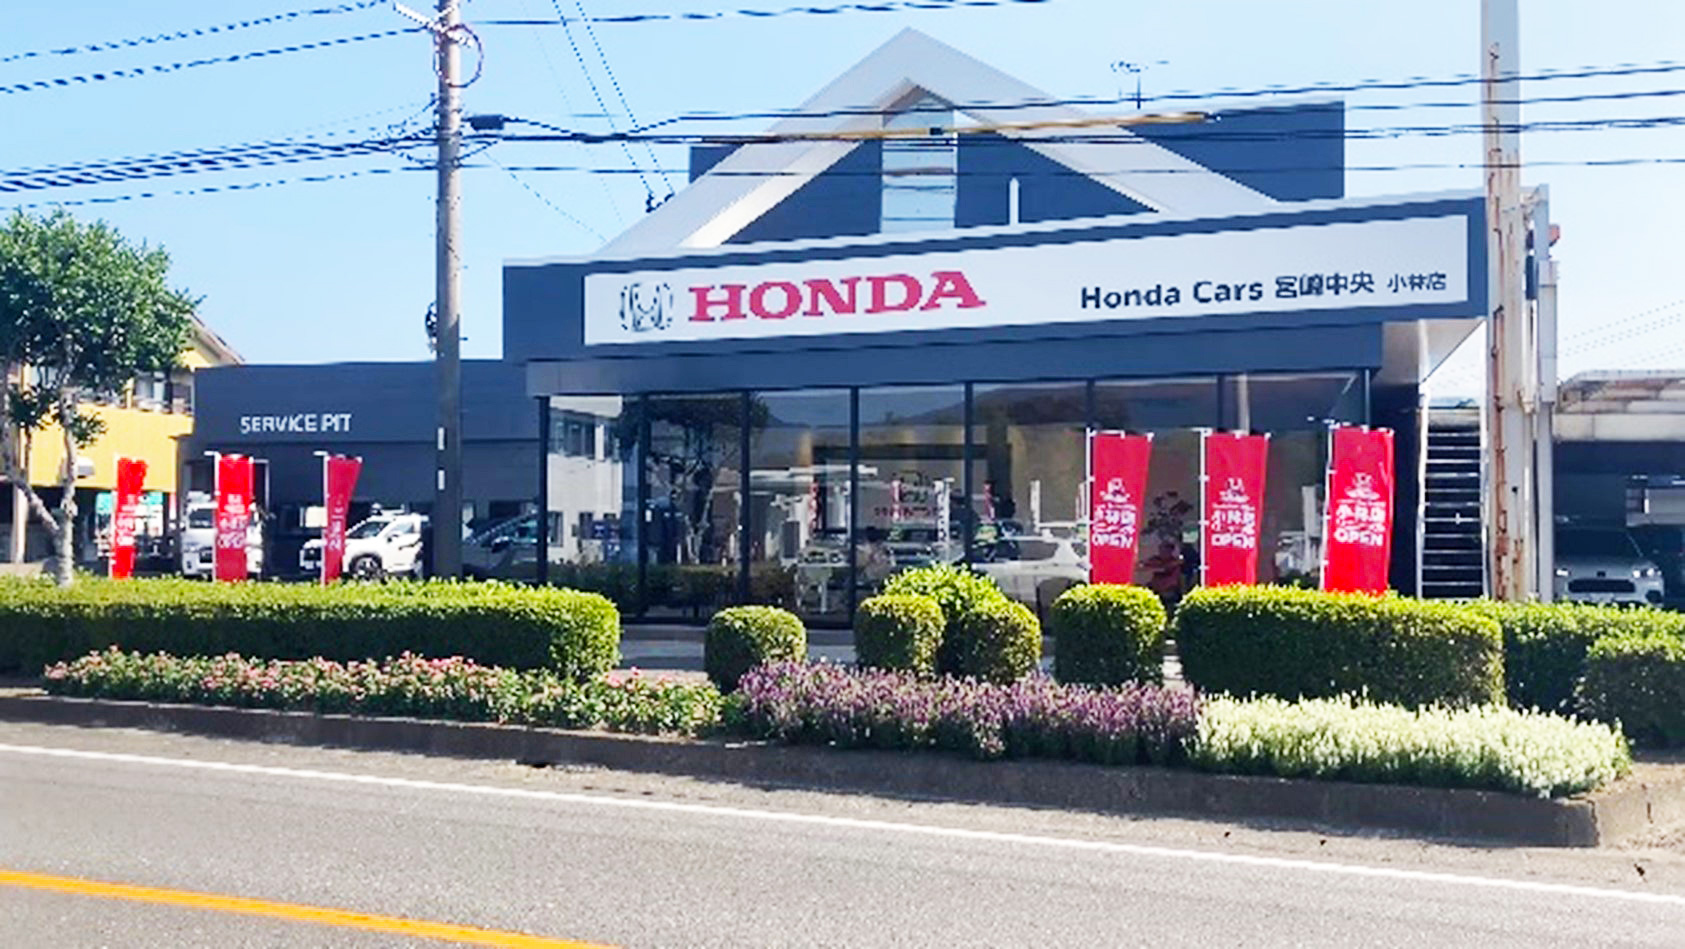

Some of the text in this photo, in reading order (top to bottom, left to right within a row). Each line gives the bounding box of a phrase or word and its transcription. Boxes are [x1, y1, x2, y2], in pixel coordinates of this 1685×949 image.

[688, 271, 987, 322] HONDA
[1081, 284, 1181, 309] Honda
[1193, 281, 1263, 303] Cars
[1387, 271, 1447, 293] 小林店
[240, 413, 352, 434] SERVICE PIT
[1092, 532, 1134, 548] OPEN
[1334, 527, 1383, 546] OPEN
